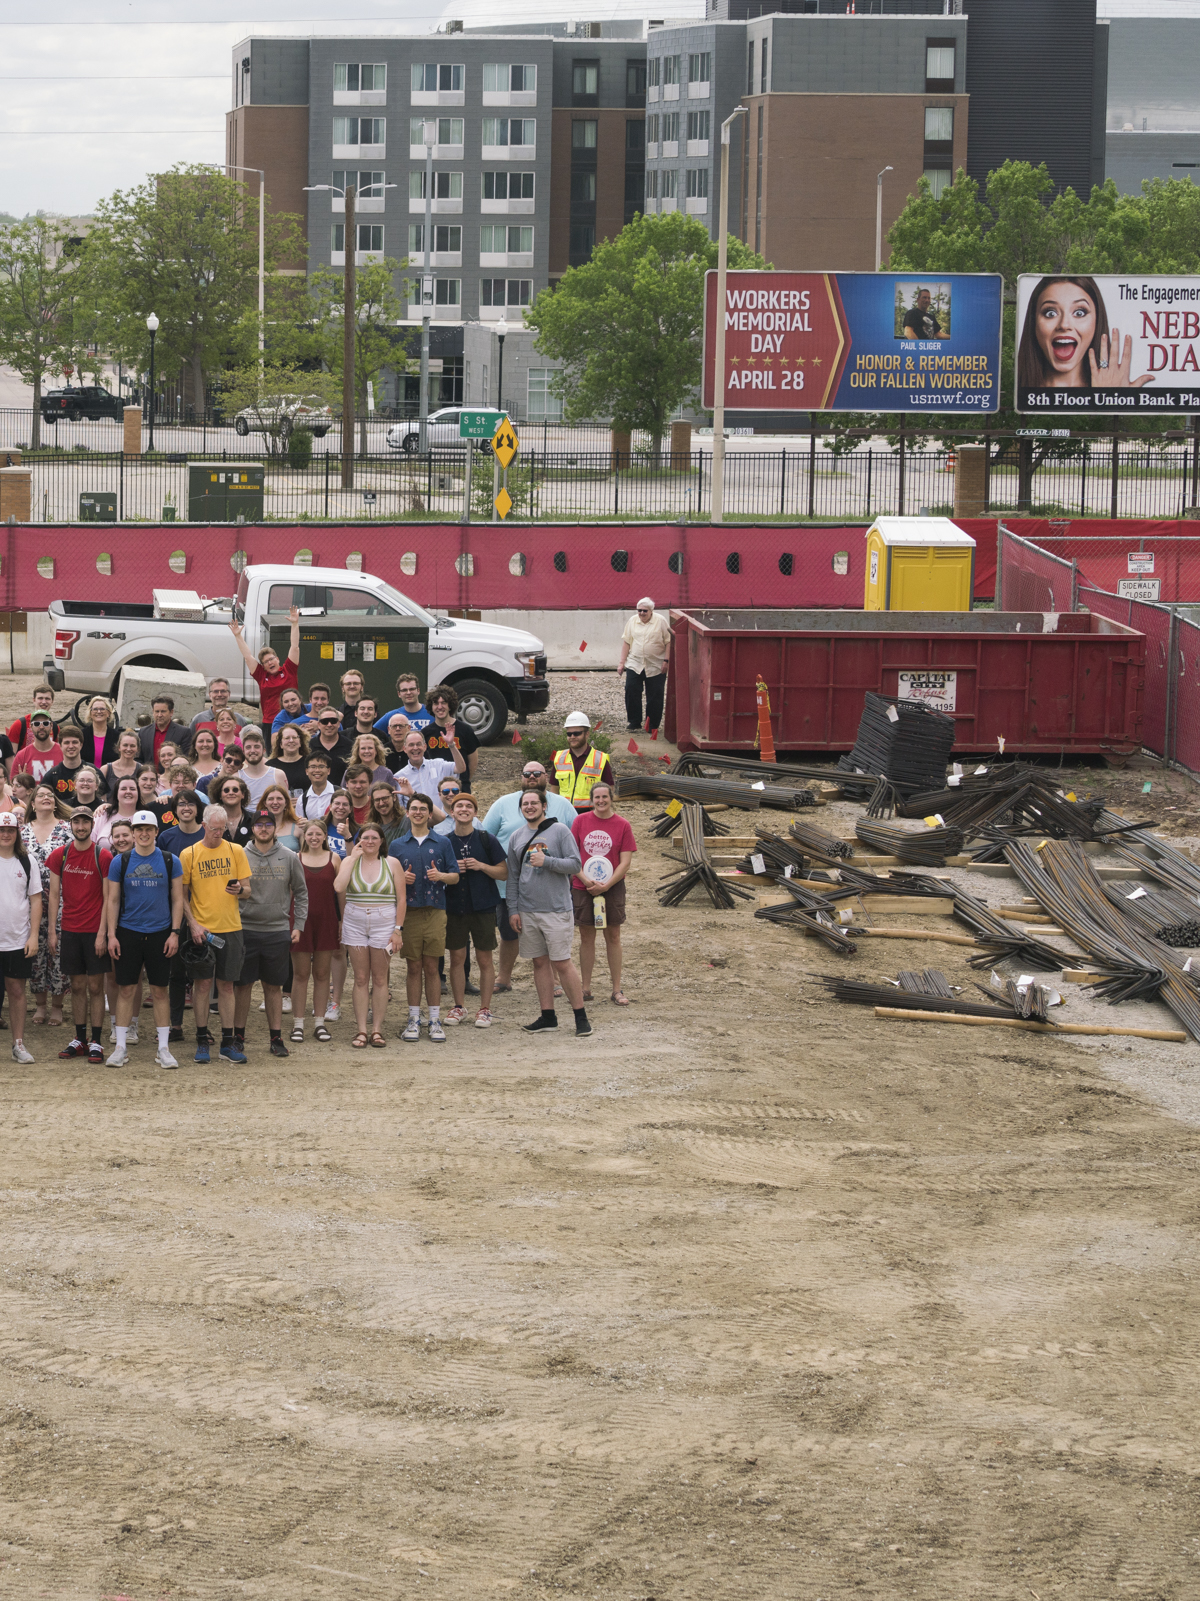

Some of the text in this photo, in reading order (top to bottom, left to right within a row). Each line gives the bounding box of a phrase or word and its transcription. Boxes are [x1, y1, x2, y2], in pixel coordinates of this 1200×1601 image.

[726, 290, 810, 310] WORKERS
[1118, 284, 1138, 300] The
[725, 312, 812, 332] MEMORIAL
[1140, 311, 1200, 339] NEB
[751, 334, 784, 353] DAY
[900, 342, 941, 350] PAUL SLIGER
[856, 354, 988, 371] HONOR & REMEMBER
[1147, 343, 1200, 372] DIA
[728, 370, 804, 390] APRIL 28
[850, 373, 993, 389] OUR FALLEN WORKERS
[910, 391, 990, 408] usmwf.org
[1027, 392, 1200, 406] 8th Floor Union Bank Pla
[463, 417, 488, 425] S St.
[1125, 591, 1152, 599] CLOSED
[899, 673, 954, 682] CAPITAL
[32, 760, 54, 782] N
[198, 858, 231, 872] LINCOLN
[199, 871, 218, 879] TRACK
